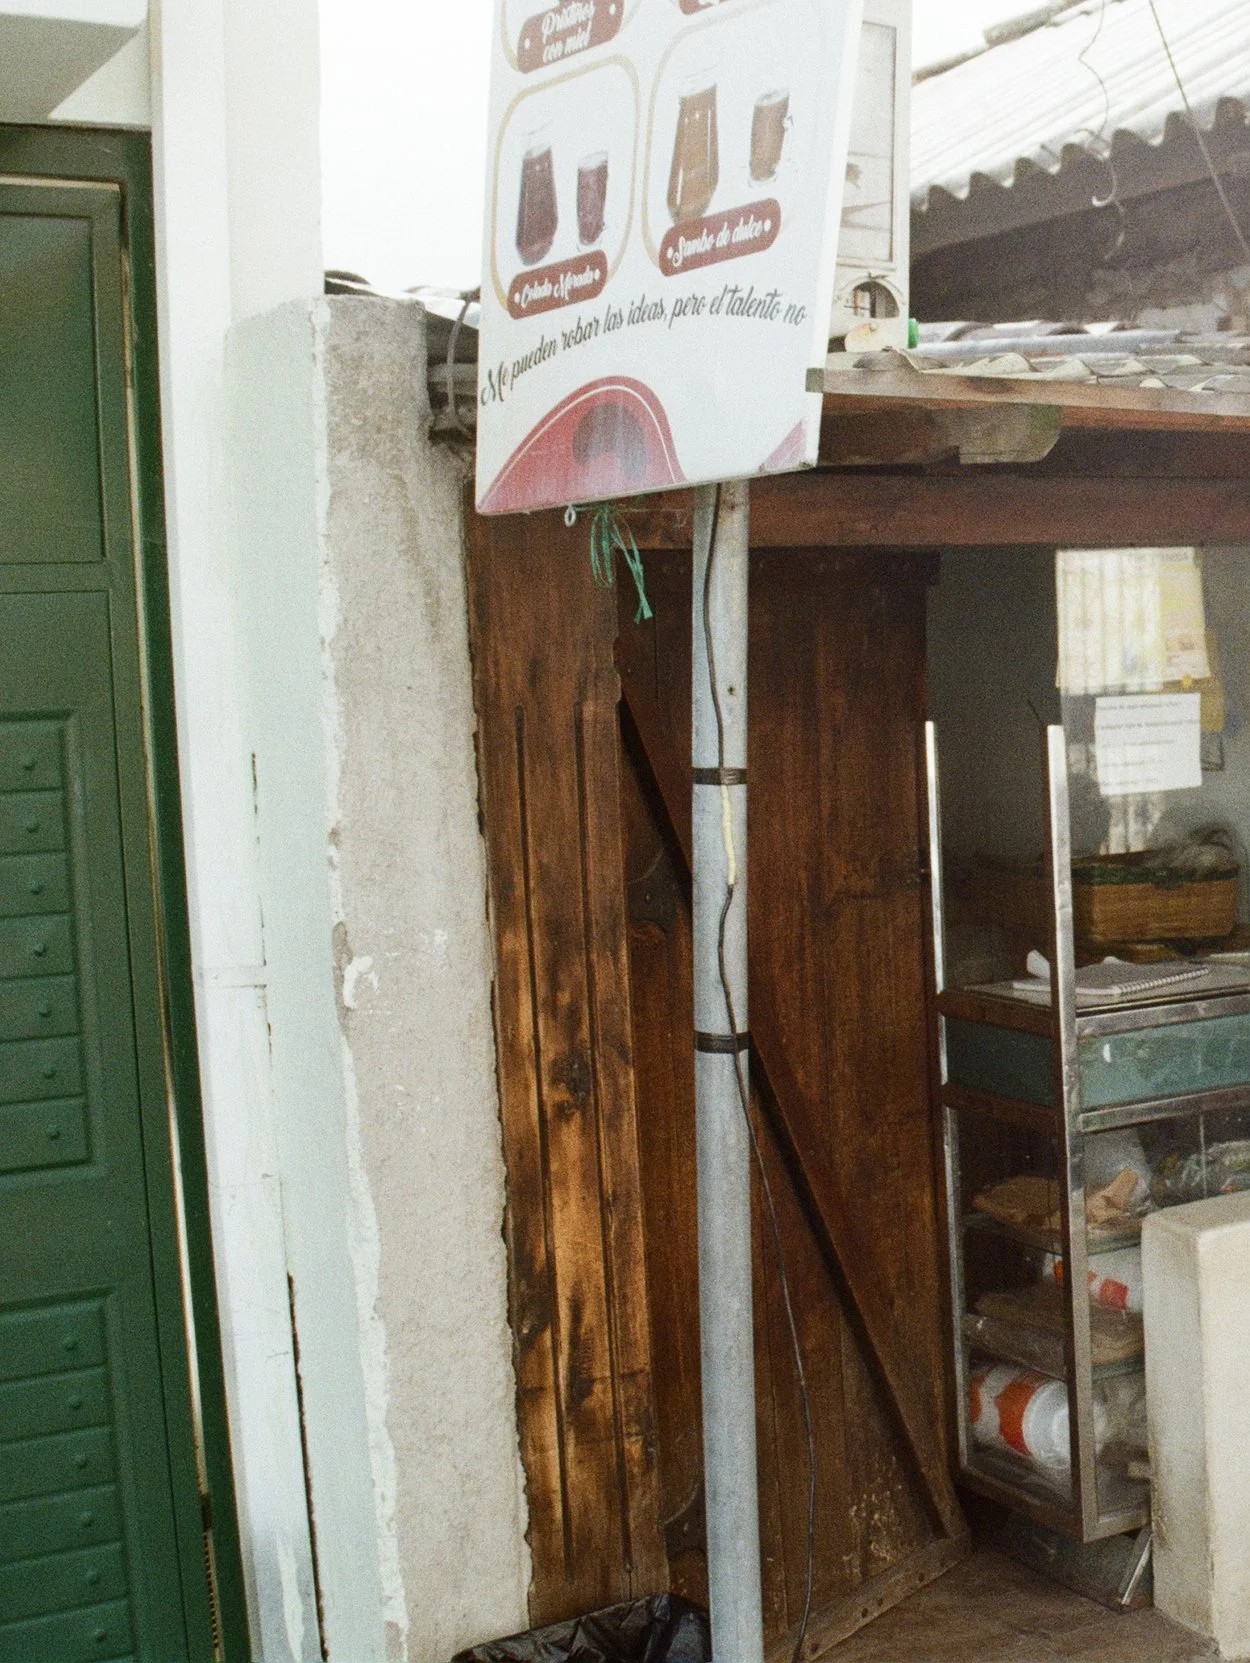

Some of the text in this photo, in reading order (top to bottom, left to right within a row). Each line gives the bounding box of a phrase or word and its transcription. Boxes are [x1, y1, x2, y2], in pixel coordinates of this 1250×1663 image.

[715, 221, 731, 249] de
[732, 214, 763, 244] dulce
[480, 284, 808, 406] Me pueden robar las ideas, pero el talento no
